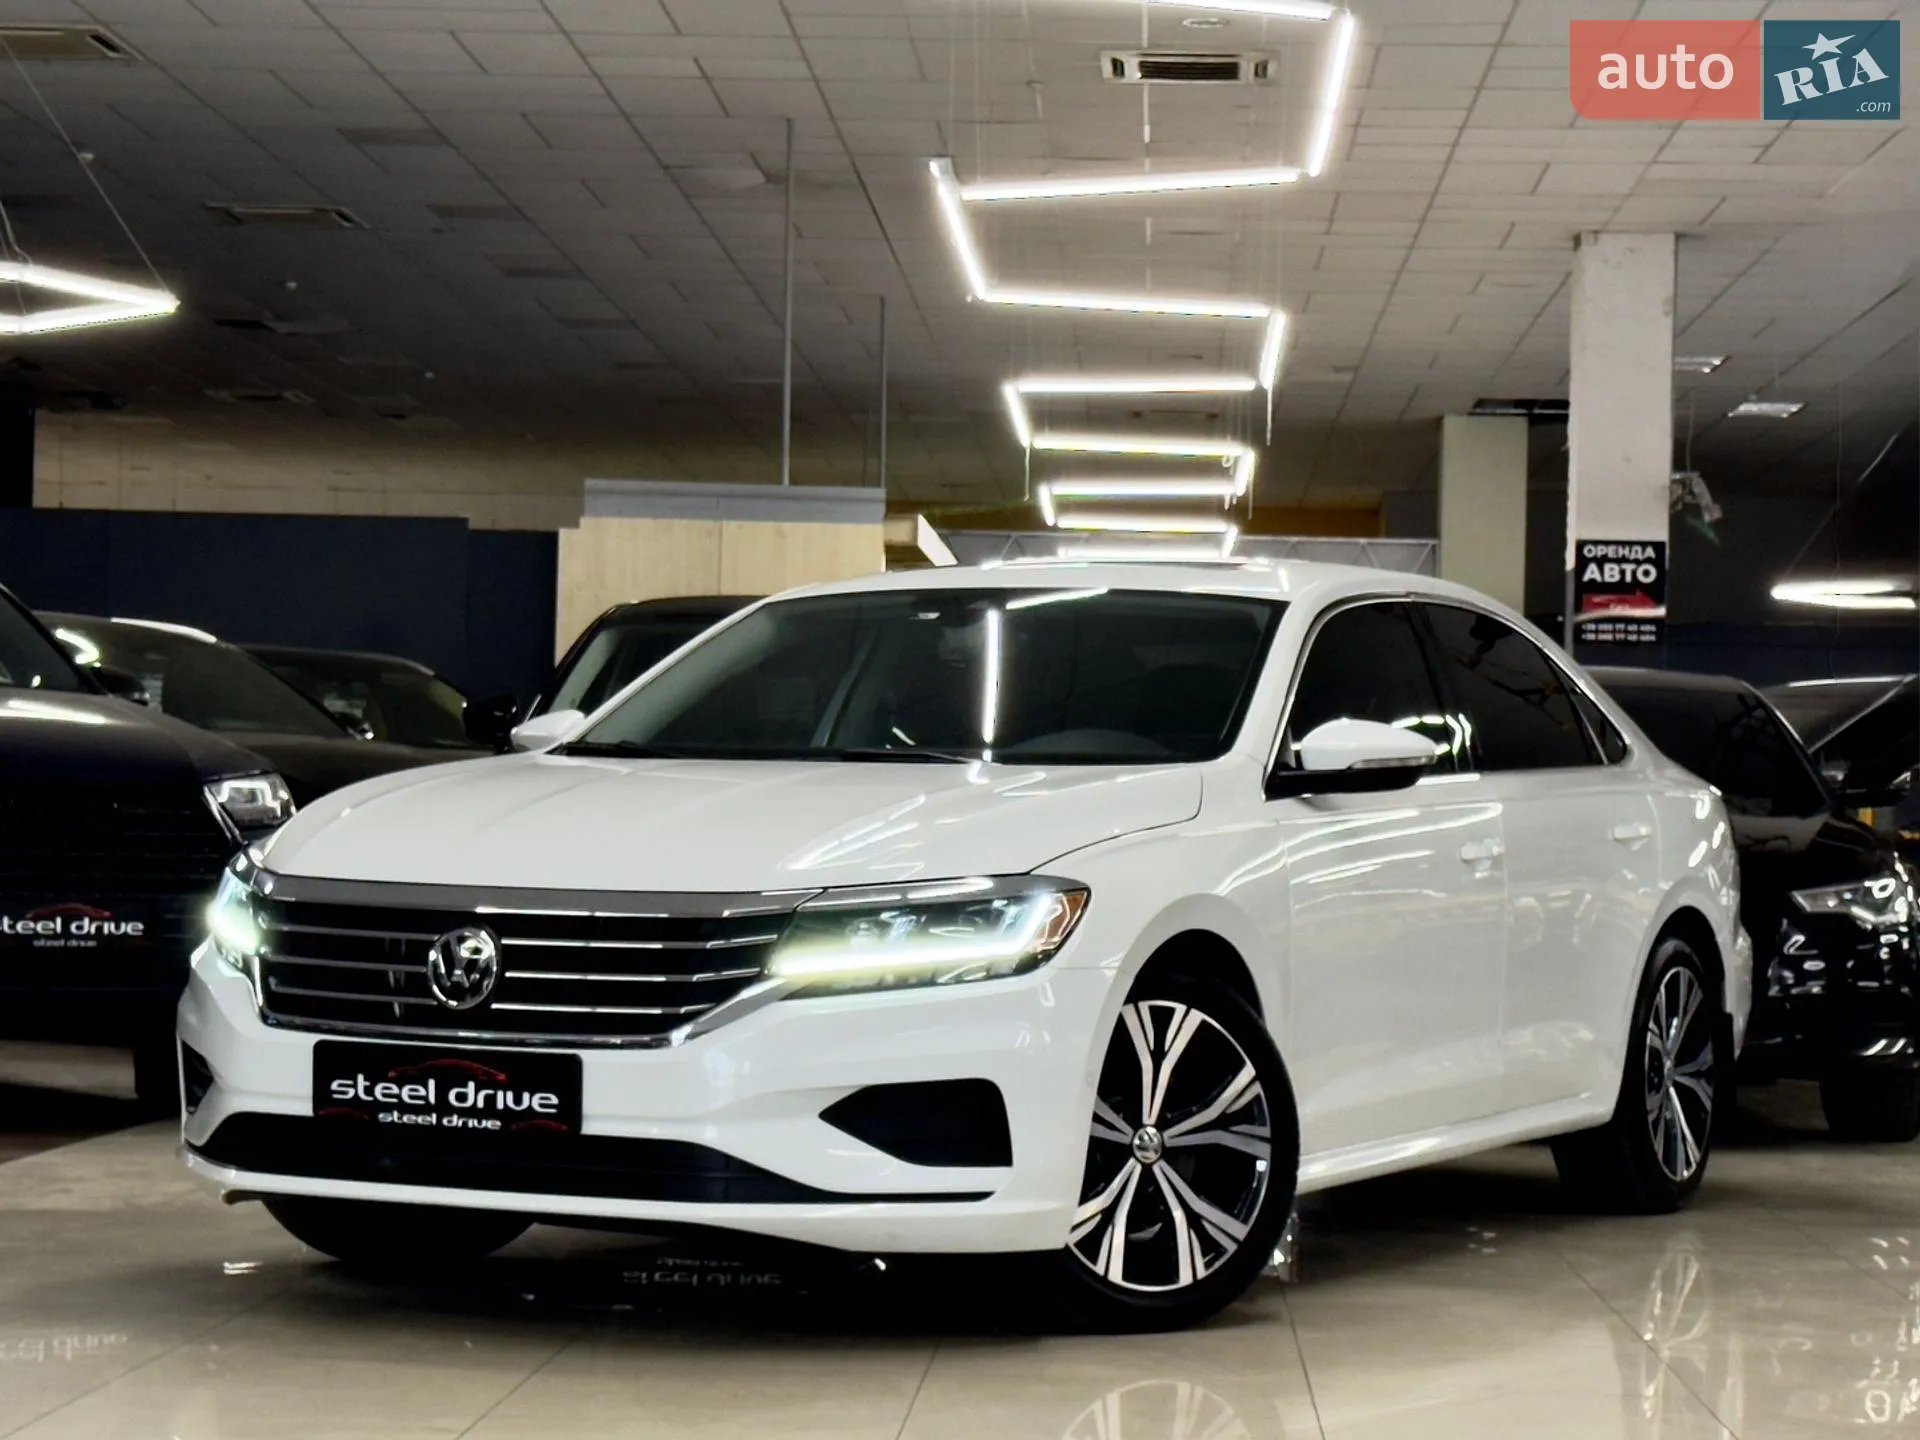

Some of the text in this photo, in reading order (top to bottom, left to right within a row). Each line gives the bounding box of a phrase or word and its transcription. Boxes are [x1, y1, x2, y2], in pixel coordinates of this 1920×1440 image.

[1583, 544, 1656, 561] ОРЕНДА
[1582, 562, 1657, 584] АВТО
[0, 915, 144, 936] teel drive
[330, 1073, 559, 1113] steel drive
[377, 1110, 502, 1130] steel drive
